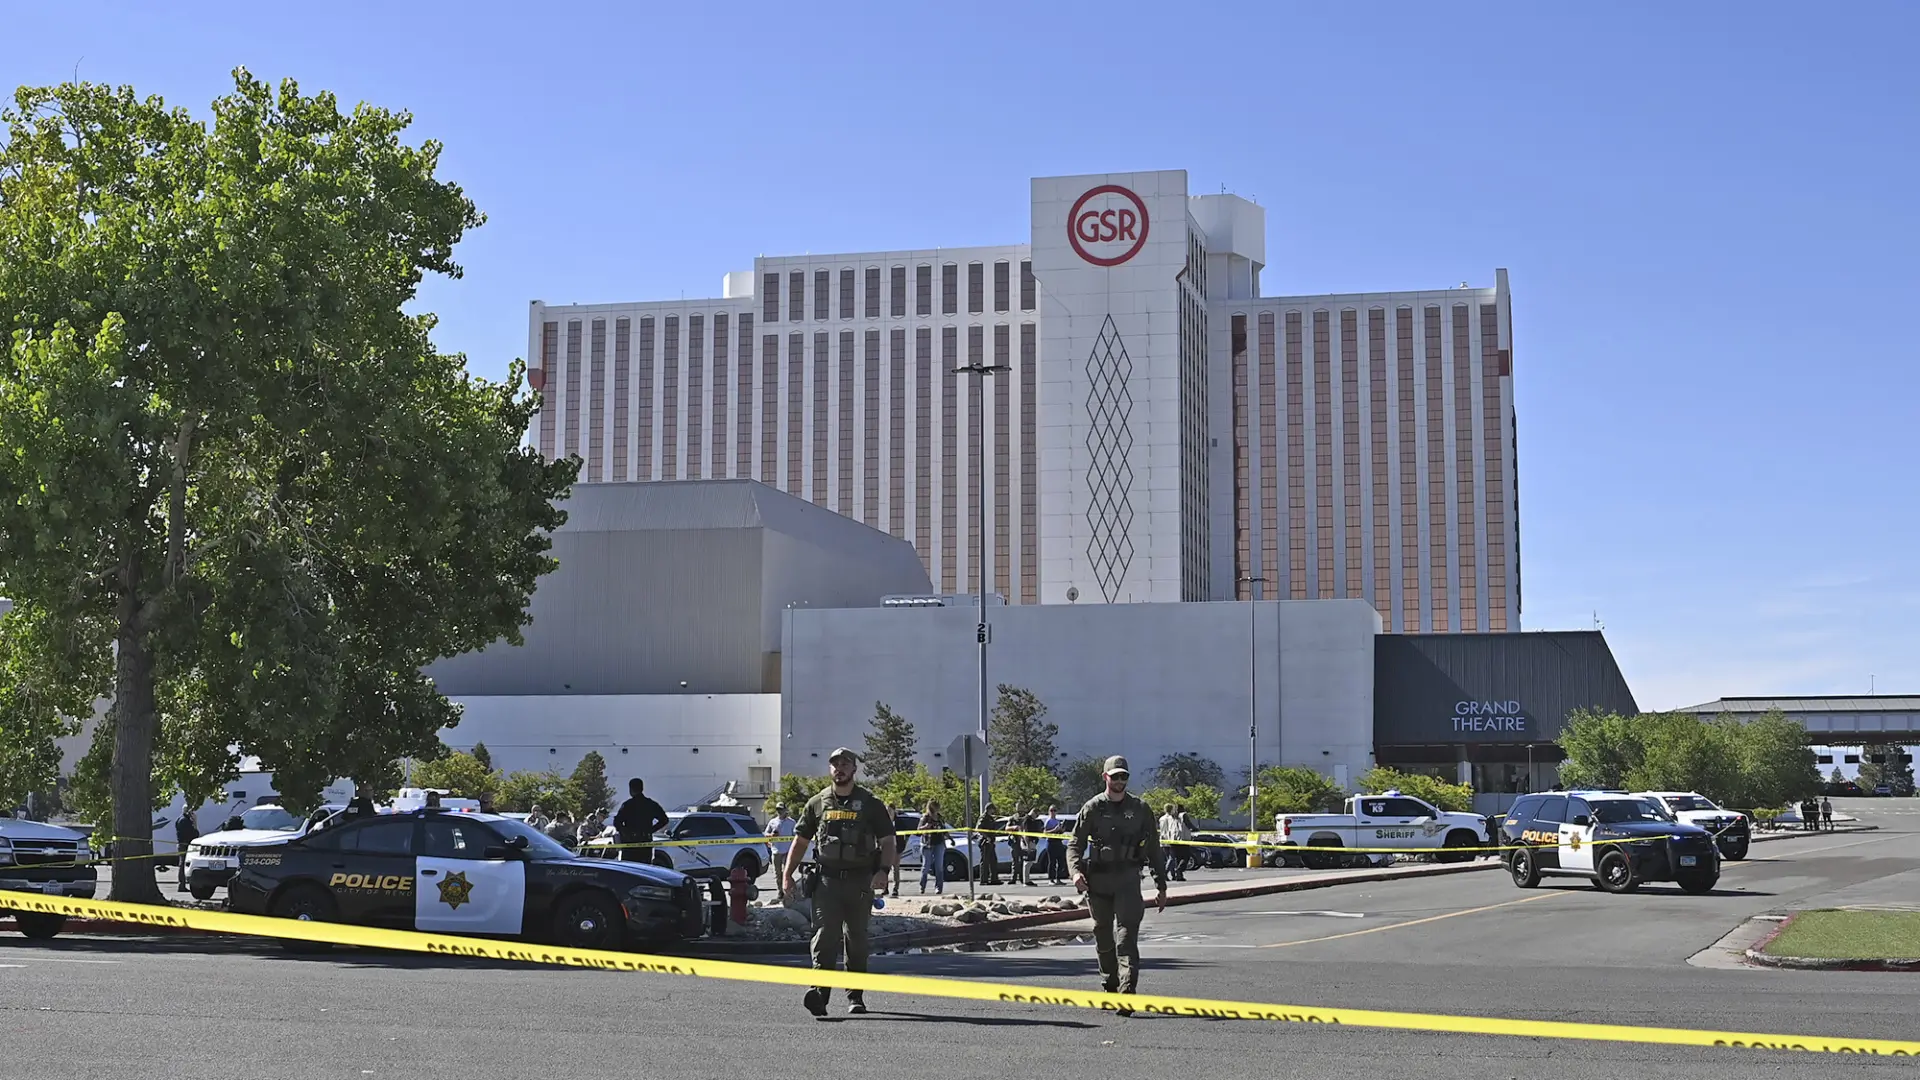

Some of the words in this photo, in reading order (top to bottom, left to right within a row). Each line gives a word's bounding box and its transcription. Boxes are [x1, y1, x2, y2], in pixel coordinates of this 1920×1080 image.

[1077, 209, 1136, 243] GSR
[977, 623, 986, 643] 2B
[1455, 700, 1520, 715] GRAND
[1451, 717, 1525, 731] THEATRE
[826, 811, 858, 820] SHERIFF
[1372, 805, 1384, 813] K9
[1521, 830, 1559, 843] POLICE
[243, 858, 281, 866] 334-COPS
[329, 872, 414, 891] POLICE
[336, 887, 360, 895] CITY
